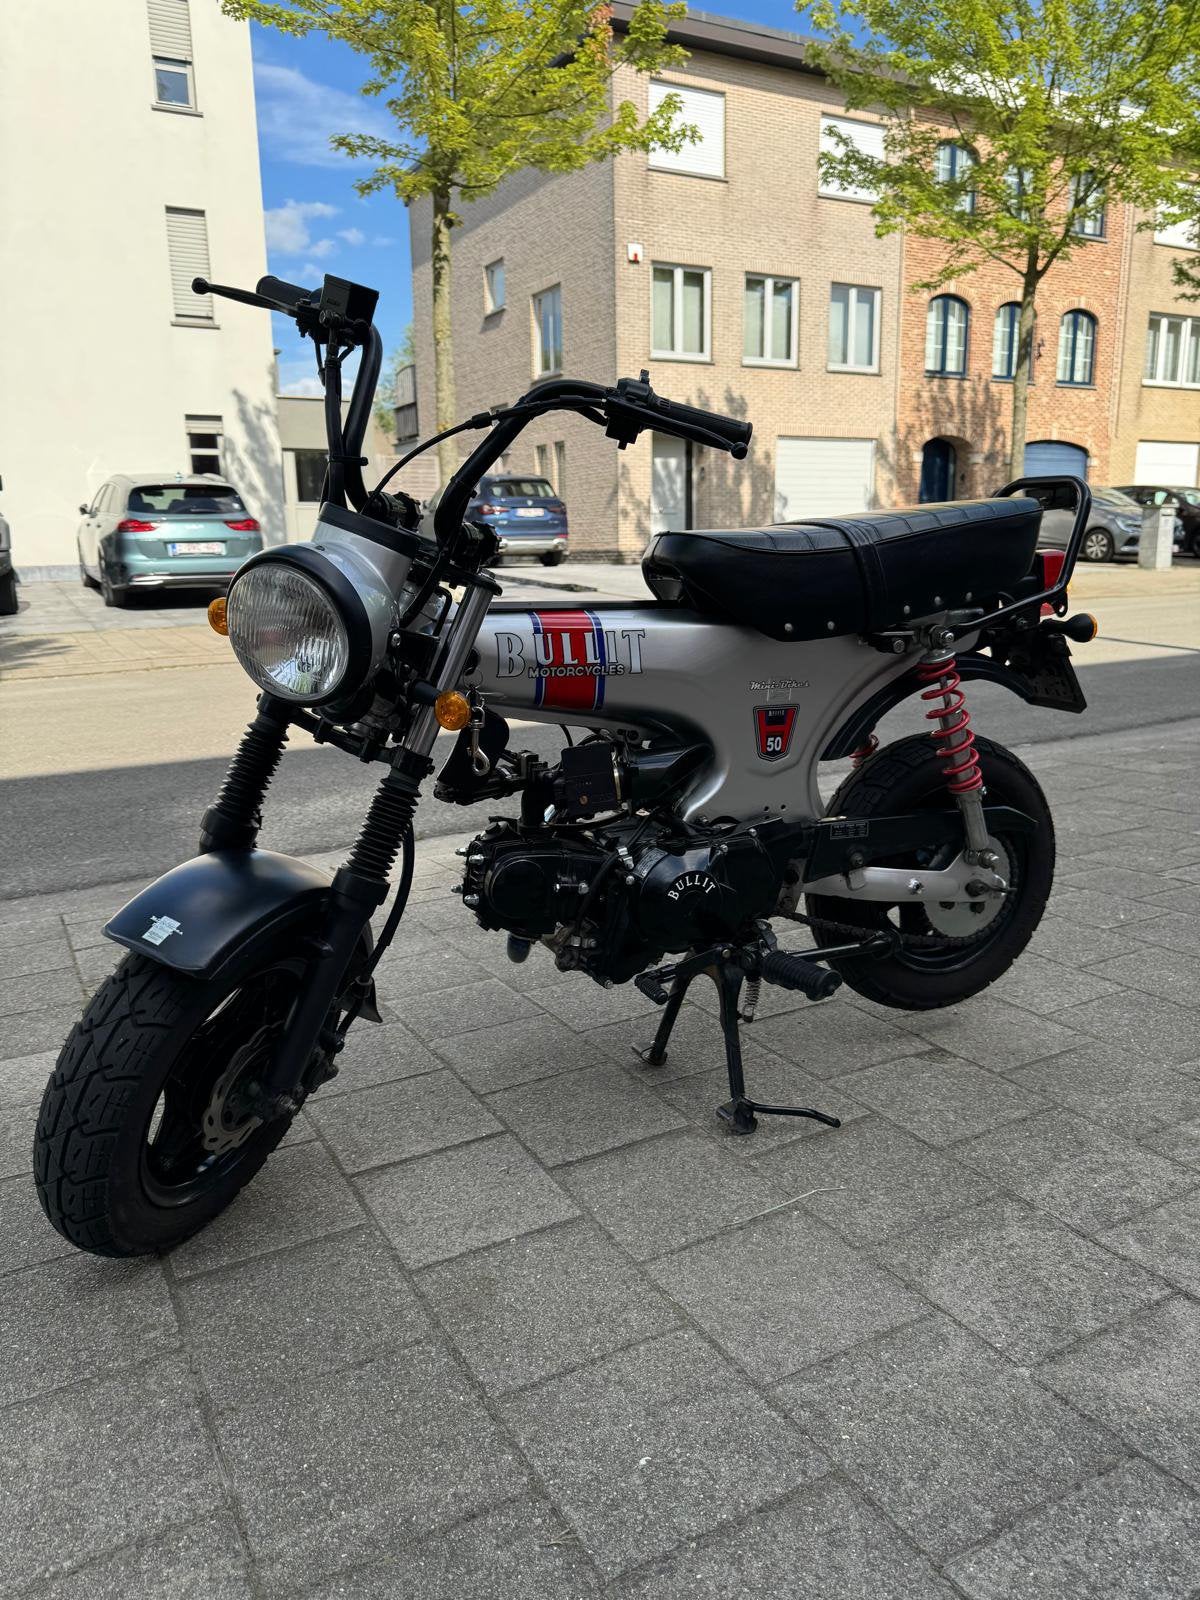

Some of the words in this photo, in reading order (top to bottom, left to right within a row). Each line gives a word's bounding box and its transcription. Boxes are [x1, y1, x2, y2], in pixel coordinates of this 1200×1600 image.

[495, 628, 646, 678] BULLIT
[527, 662, 625, 679] MOTORCYCLES
[766, 736, 782, 752] 50
[667, 874, 716, 901] BULLIT
